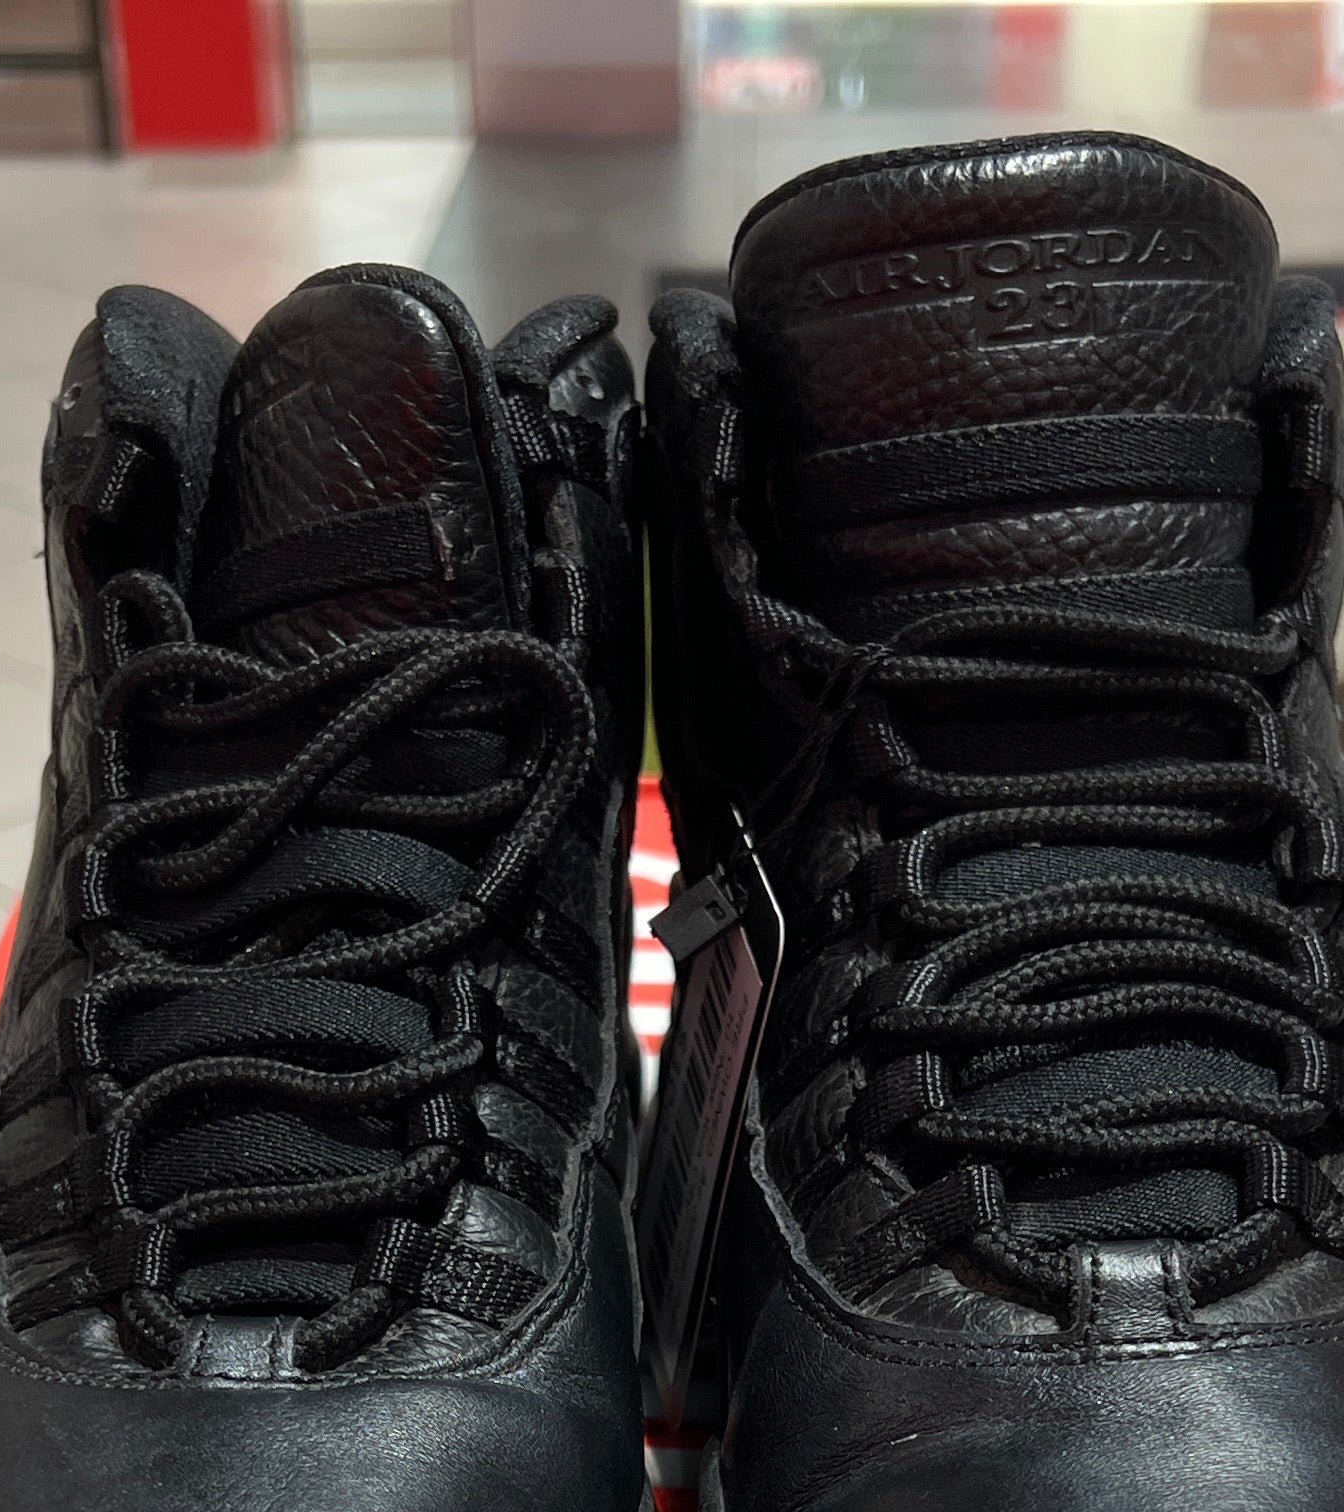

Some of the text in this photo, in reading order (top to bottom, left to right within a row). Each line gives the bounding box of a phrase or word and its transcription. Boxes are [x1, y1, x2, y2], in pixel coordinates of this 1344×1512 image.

[799, 227, 1224, 303] AIR JORDAN
[984, 280, 1088, 336] 23
